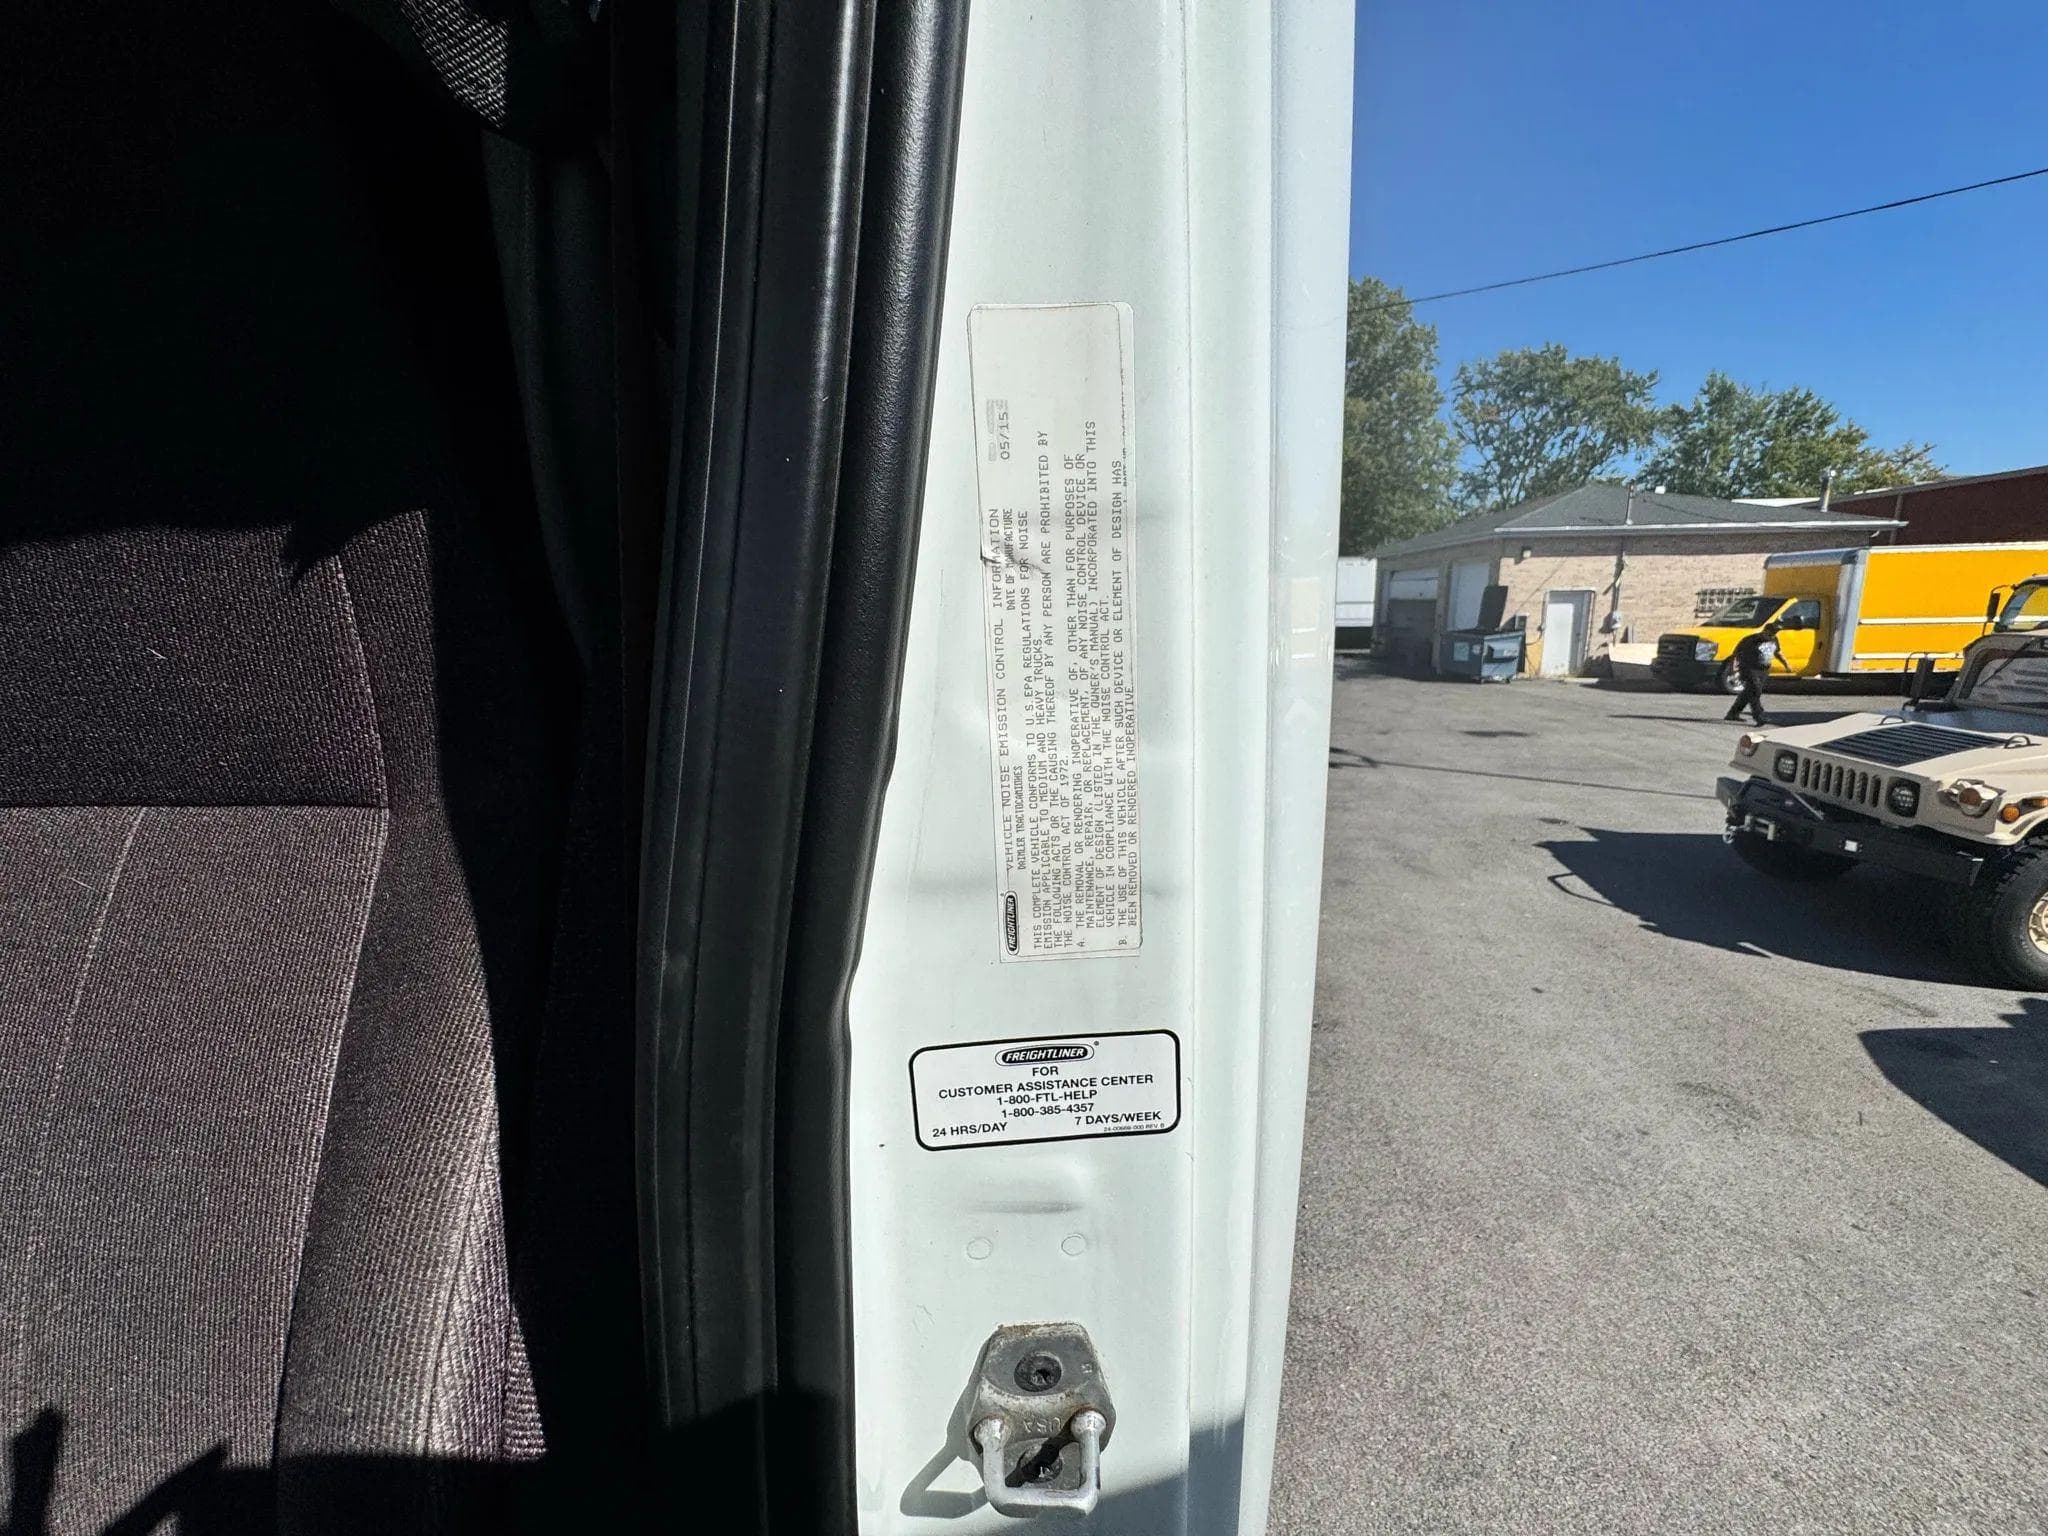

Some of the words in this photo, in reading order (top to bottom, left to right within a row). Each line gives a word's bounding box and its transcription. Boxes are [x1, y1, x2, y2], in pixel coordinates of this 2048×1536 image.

[998, 411, 1010, 460] 05/15
[1037, 431, 1048, 447] BY
[1085, 420, 1096, 452] THIS
[1063, 454, 1074, 470] OF
[1074, 453, 1085, 469] OR
[1110, 459, 1121, 484] HAS
[1086, 461, 1097, 492] INTO
[1037, 454, 1050, 533] PROHIBITED
[1074, 477, 1086, 525] DEVICE
[1063, 478, 1076, 540] PURPOSES
[1111, 491, 1122, 538] DESIGN
[1002, 508, 1014, 568] MANUFACTURE
[1017, 510, 1029, 549] NOISE
[988, 508, 1003, 608] INFORMATION
[1040, 541, 1051, 564] ARE
[1065, 547, 1076, 571] FOR
[1076, 532, 1088, 585] CONTROL
[1087, 501, 1099, 591] INCORPORATED
[1112, 546, 1122, 561] OF
[1004, 572, 1015, 583] OF
[1019, 558, 1030, 580] FOR
[1005, 588, 1016, 610] DATE
[1041, 571, 1053, 616] PERSON
[1066, 578, 1077, 607] THAN
[1112, 569, 1123, 620] ELEMENT
[1077, 593, 1089, 630] NOISE
[1099, 594, 1110, 622] ACT.
[1020, 587, 1033, 668] REGULATIONS
[1043, 623, 1054, 646] ANY
[1067, 615, 1078, 652] OTHER
[1089, 600, 1100, 651] MANUAL)
[1113, 628, 1123, 643] OR
[993, 618, 1006, 679] CONTROL
[1044, 653, 1055, 667] BY
[1078, 637, 1089, 659] ANY
[1100, 629, 1111, 679] CONTROL
[1079, 666, 1090, 680] OF
[1090, 658, 1101, 708] OWNER'S
[1113, 651, 1124, 693] DEVICE
[1034, 690, 1046, 725] HEAVY
[1045, 676, 1056, 724] THEREOF
[1101, 687, 1112, 722] NOISE
[1114, 700, 1125, 728] SUCH
[996, 688, 1009, 756] EMISSION
[1069, 688, 1081, 764] INOPERATIVE
[1091, 715, 1102, 735] THE
[1025, 732, 1036, 745] TO
[1036, 732, 1046, 752] AND
[1092, 743, 1102, 756] IN
[1102, 729, 1112, 749] THE
[1115, 735, 1125, 770] AFTER
[1047, 732, 1058, 781] CAUSING
[1102, 757, 1113, 785] WITH
[1000, 765, 1012, 806] NOISE
[1026, 753, 1038, 809] CONFORMS
[1037, 760, 1048, 802] MEDIUM
[1082, 779, 1092, 792] OR
[1092, 764, 1103, 812] (LISTED
[1048, 788, 1059, 807] THE
[1059, 795, 1070, 808] OF
[1071, 773, 1083, 834] RENDERING
[1115, 778, 1126, 825] VEHICLE
[1126, 770, 1137, 825] RENDERED
[1038, 809, 1049, 822] TO
[1049, 815, 1060, 829] OR
[1060, 814, 1071, 835] ACT
[1103, 792, 1114, 859] COMPLIANCE
[1002, 815, 1014, 871] VEHICLE
[1029, 816, 1040, 863] VEHICLE
[1050, 835, 1061, 862] ACTS
[1073, 840, 1083, 854] OR
[1094, 819, 1104, 859] DESIGN
[1116, 831, 1127, 858] THIS
[1127, 831, 1137, 844] OR
[1016, 837, 1026, 869] DAIMLER
[1039, 829, 1051, 893] APPLICABLE
[1061, 841, 1072, 886] CONTROL
[1074, 861, 1085, 904] REMOVAL
[1095, 866, 1105, 879] OF
[1105, 865, 1114, 877] IN
[1117, 864, 1127, 878] OF
[1127, 852, 1137, 895] REMOVED
[1031, 869, 1042, 918] COMPLETE
[1051, 868, 1063, 924] FOLLOWING
[1062, 892, 1073, 922] NOISE
[1095, 885, 1106, 928] ELEMENT
[1105, 884, 1115, 927] VEHICLE
[1117, 884, 1127, 902] USE
[1006, 896, 1017, 949] FREIGHTLINER
[1042, 899, 1053, 949] EMISSION
[1075, 910, 1085, 928] THE
[1118, 908, 1127, 926] THE
[1128, 901, 1138, 926] BEEN
[1033, 924, 1043, 949] THIS
[1053, 931, 1063, 948] THE
[1063, 930, 1074, 948] THE
[1076, 937, 1086, 947] A.
[1118, 935, 1128, 945] B.
[1005, 1047, 1085, 1063] FREIGHTLINER
[1032, 1066, 1059, 1077] FOR
[938, 1083, 1013, 1099] CUSTOMER
[1017, 1077, 1098, 1093] ASSISTANCE
[1101, 1074, 1154, 1087] CENTER
[996, 1089, 1098, 1106] 1-800-FTL-HELP
[1001, 1102, 1094, 1119] 1-800-385-4357
[1074, 1116, 1082, 1125] 7
[1085, 1110, 1162, 1125] DAYS/WEEK
[932, 1128, 947, 1138] 24
[950, 1121, 1008, 1136] HRS/DAY
